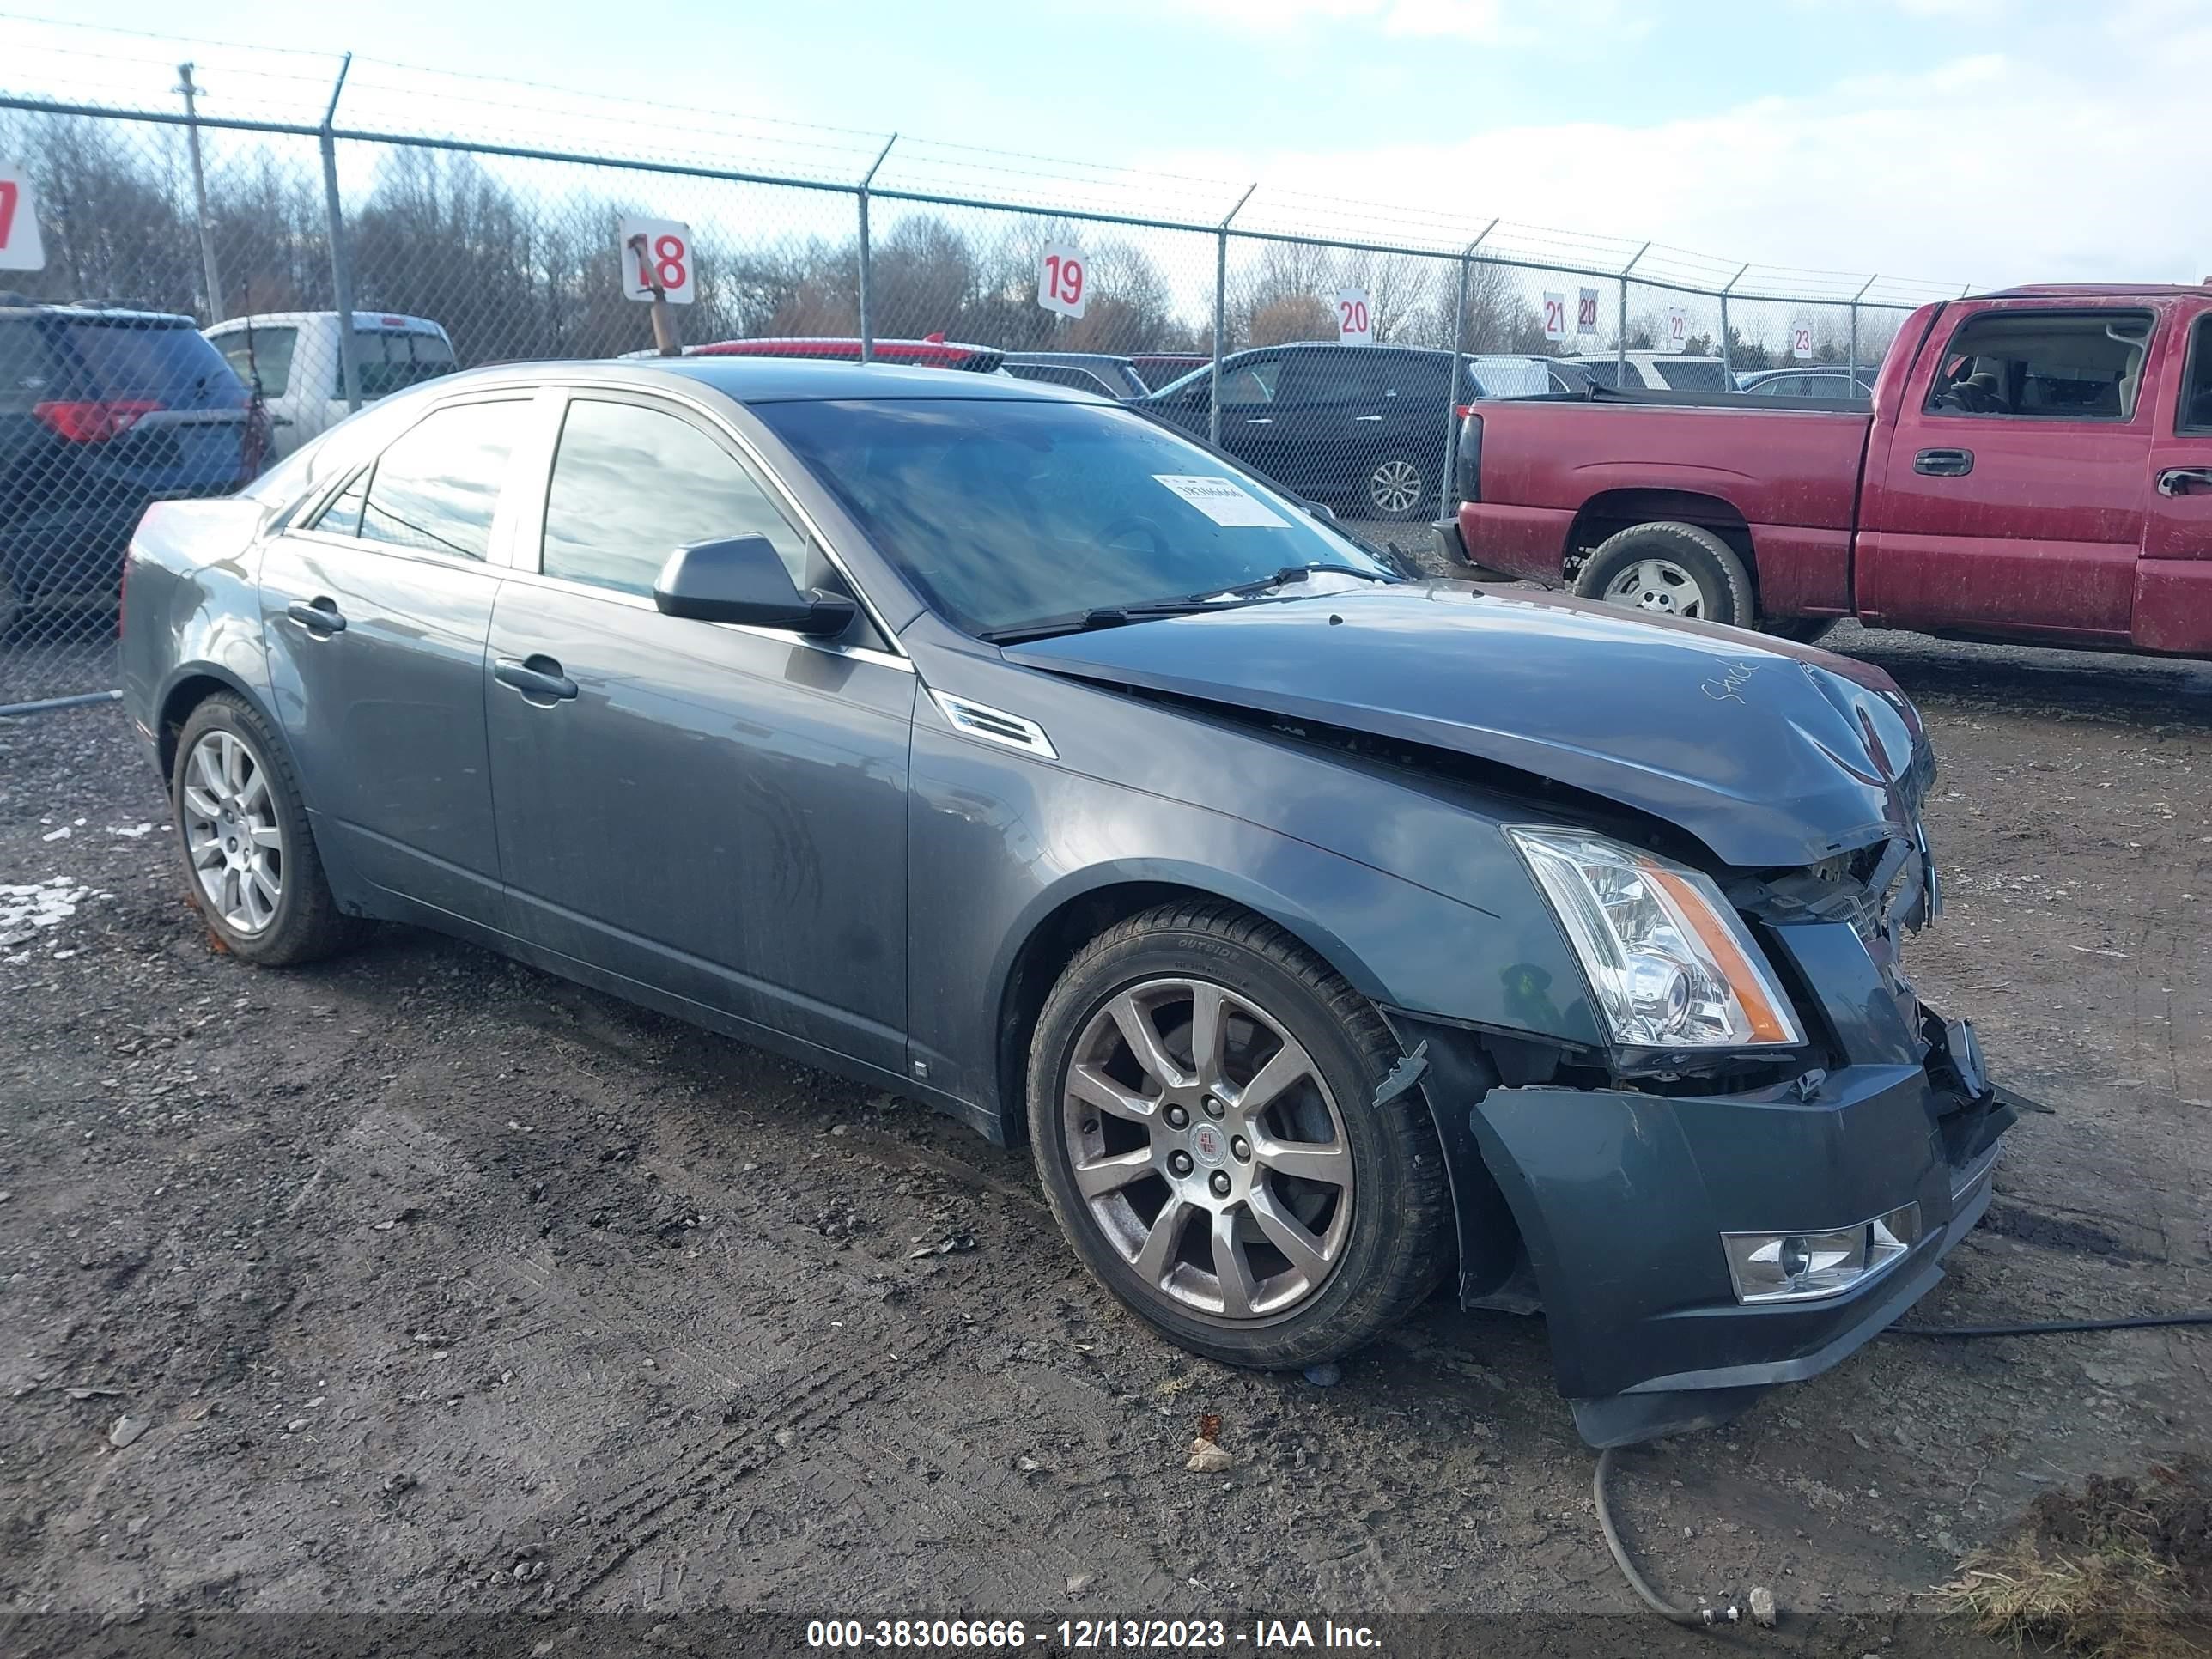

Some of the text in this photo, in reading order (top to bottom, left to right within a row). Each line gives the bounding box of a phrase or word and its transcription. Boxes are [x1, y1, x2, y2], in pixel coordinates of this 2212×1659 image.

[629, 233, 686, 289] 18
[1045, 255, 1083, 304] 19
[1340, 301, 1368, 333] 20
[1547, 301, 1565, 333] 21
[1579, 298, 1596, 325] 20
[1672, 317, 1685, 340] 22
[1795, 330, 1810, 351] 23
[1178, 939, 1242, 963] OUTSIDE
